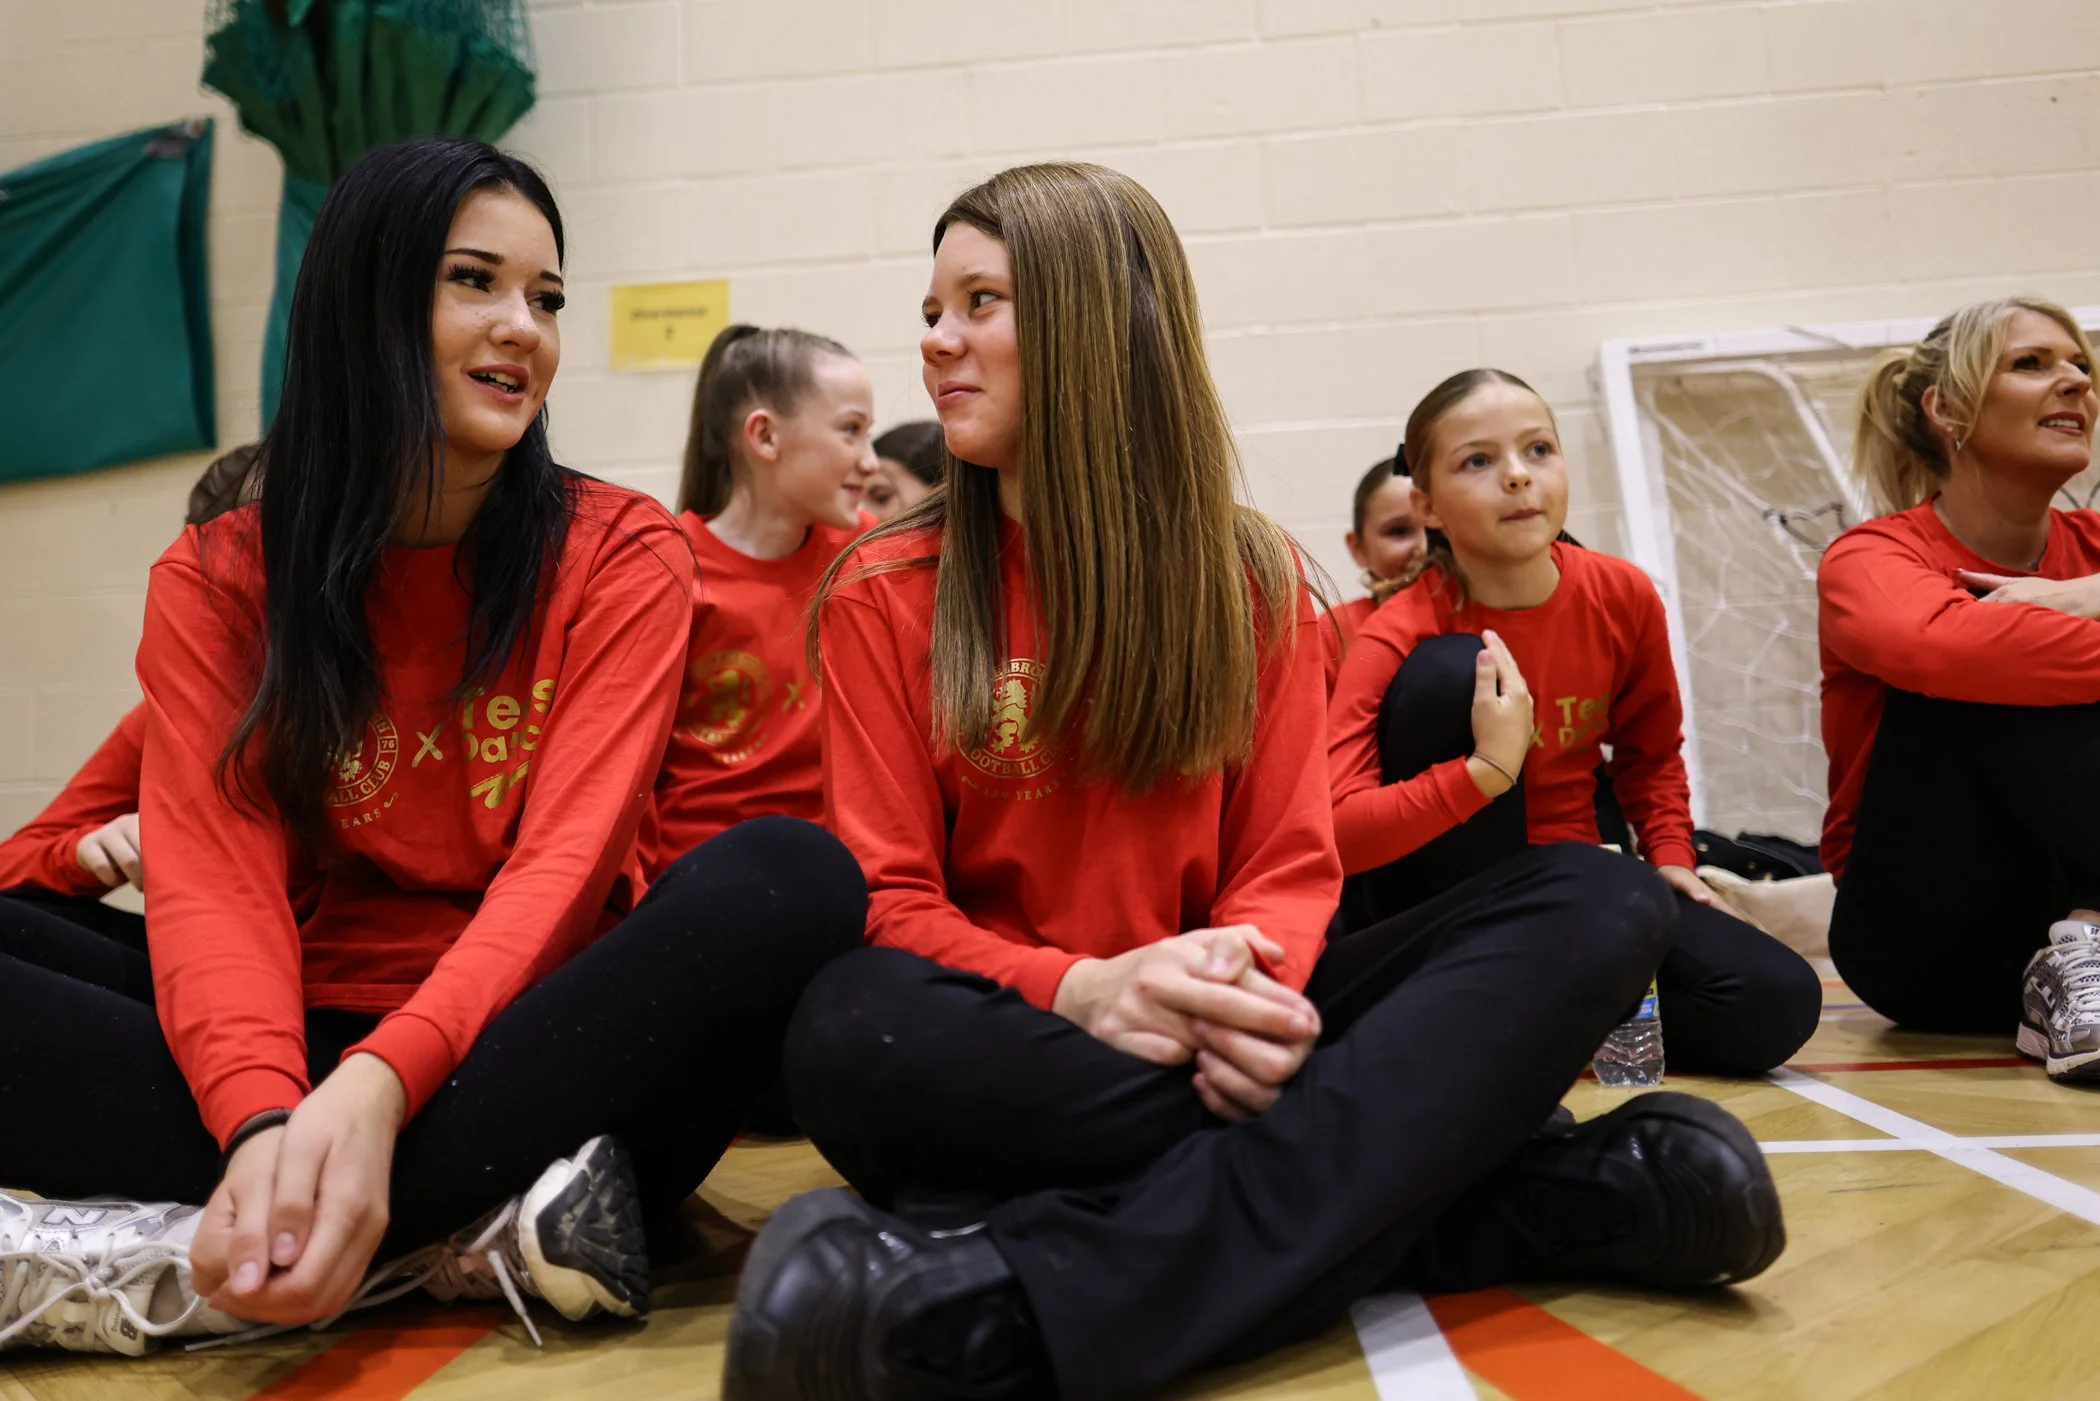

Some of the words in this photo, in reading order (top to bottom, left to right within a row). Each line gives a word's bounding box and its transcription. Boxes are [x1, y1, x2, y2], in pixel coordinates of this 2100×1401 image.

[381, 740, 395, 749] 76
[970, 750, 1040, 775] OOTBALL
[360, 760, 390, 795] CLUB
[341, 808, 381, 829] EARS
